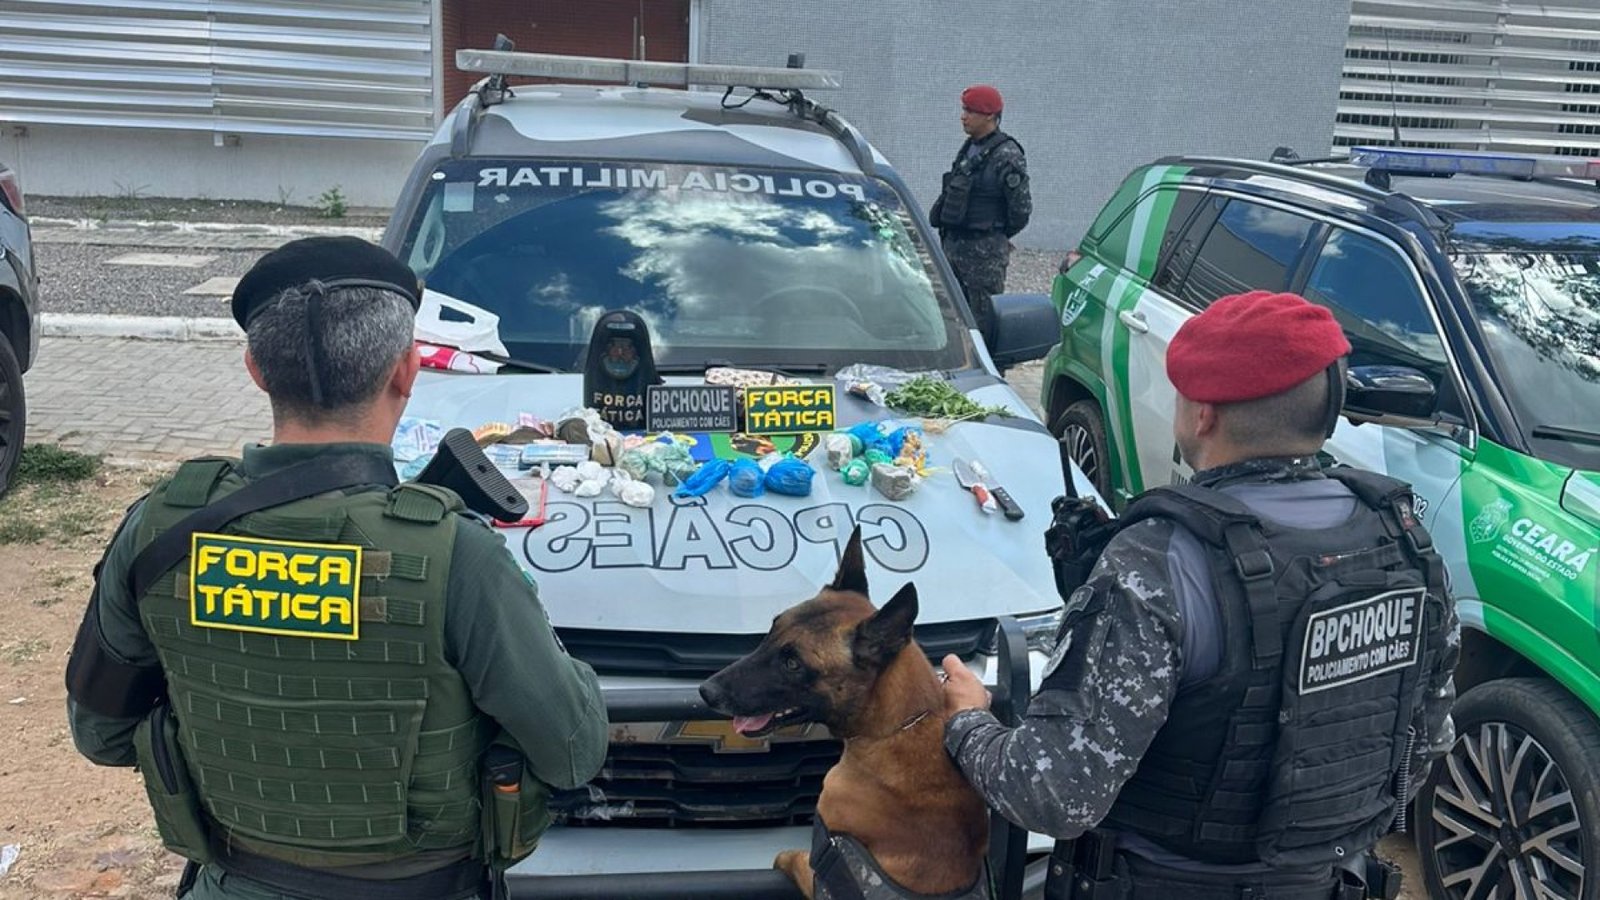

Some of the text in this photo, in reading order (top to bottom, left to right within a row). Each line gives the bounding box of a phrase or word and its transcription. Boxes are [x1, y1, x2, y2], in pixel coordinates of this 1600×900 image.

[593, 392, 643, 407] FORÇA
[652, 390, 730, 413] BPCHOQUE
[749, 390, 831, 407] FORÇA
[597, 406, 643, 421] ÁTICA
[652, 414, 730, 428] POLICIAMENTO COM CÃES
[750, 409, 832, 428] TÁTICA
[1512, 518, 1598, 573] CEARÁ
[197, 545, 352, 586] FORÇA
[1546, 560, 1577, 580] ESTADO
[197, 583, 352, 625] TÁTICA
[1310, 598, 1415, 659] BPCHOQUE
[1307, 640, 1410, 683] POLICIAMENTO COM CÃES
